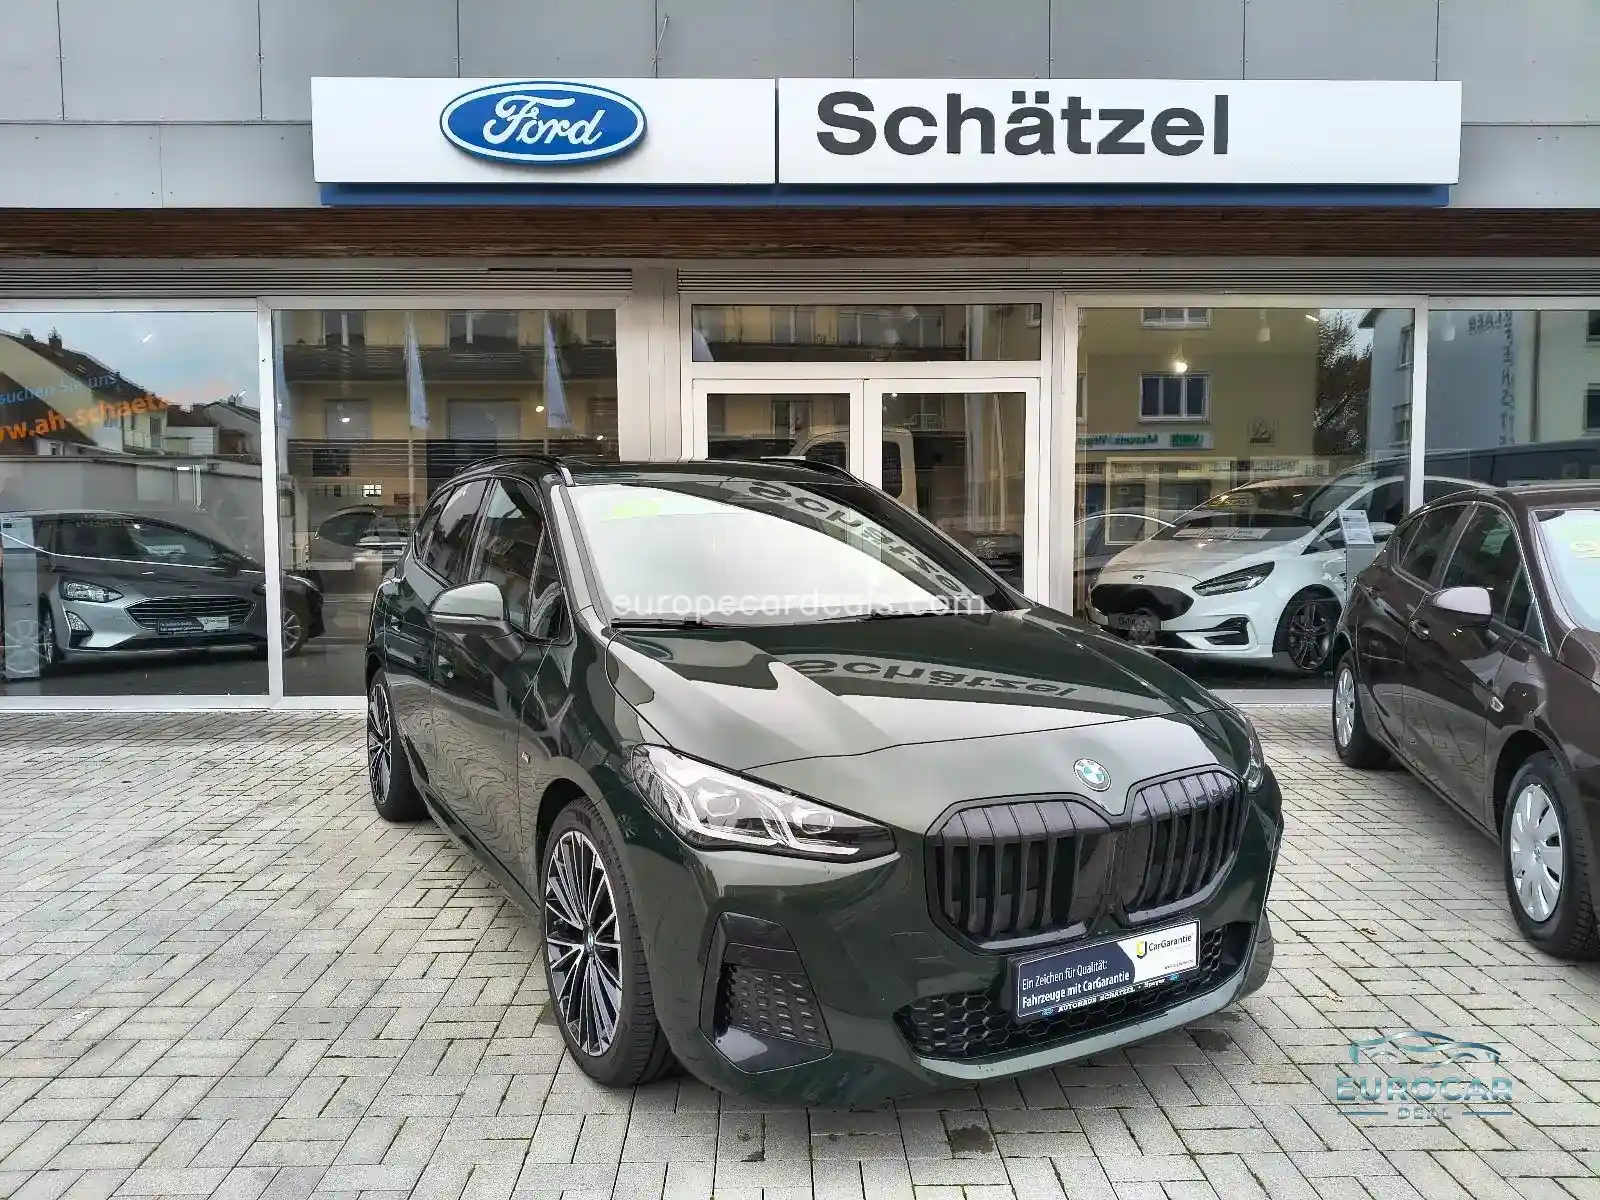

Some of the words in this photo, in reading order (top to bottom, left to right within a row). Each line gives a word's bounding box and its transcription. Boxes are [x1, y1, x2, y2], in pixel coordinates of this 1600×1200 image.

[483, 93, 607, 146] Ford
[815, 90, 1230, 156] Schätzel
[1148, 934, 1192, 952] CarGarantie
[1022, 979, 1034, 991] Ein
[1035, 972, 1064, 987] Zeichen
[1065, 966, 1076, 979] für
[1076, 959, 1108, 977] Qualität:
[1022, 989, 1066, 1009] Fahrzeuge
[1067, 982, 1082, 997] mit
[1083, 970, 1130, 992] CarGarantie
